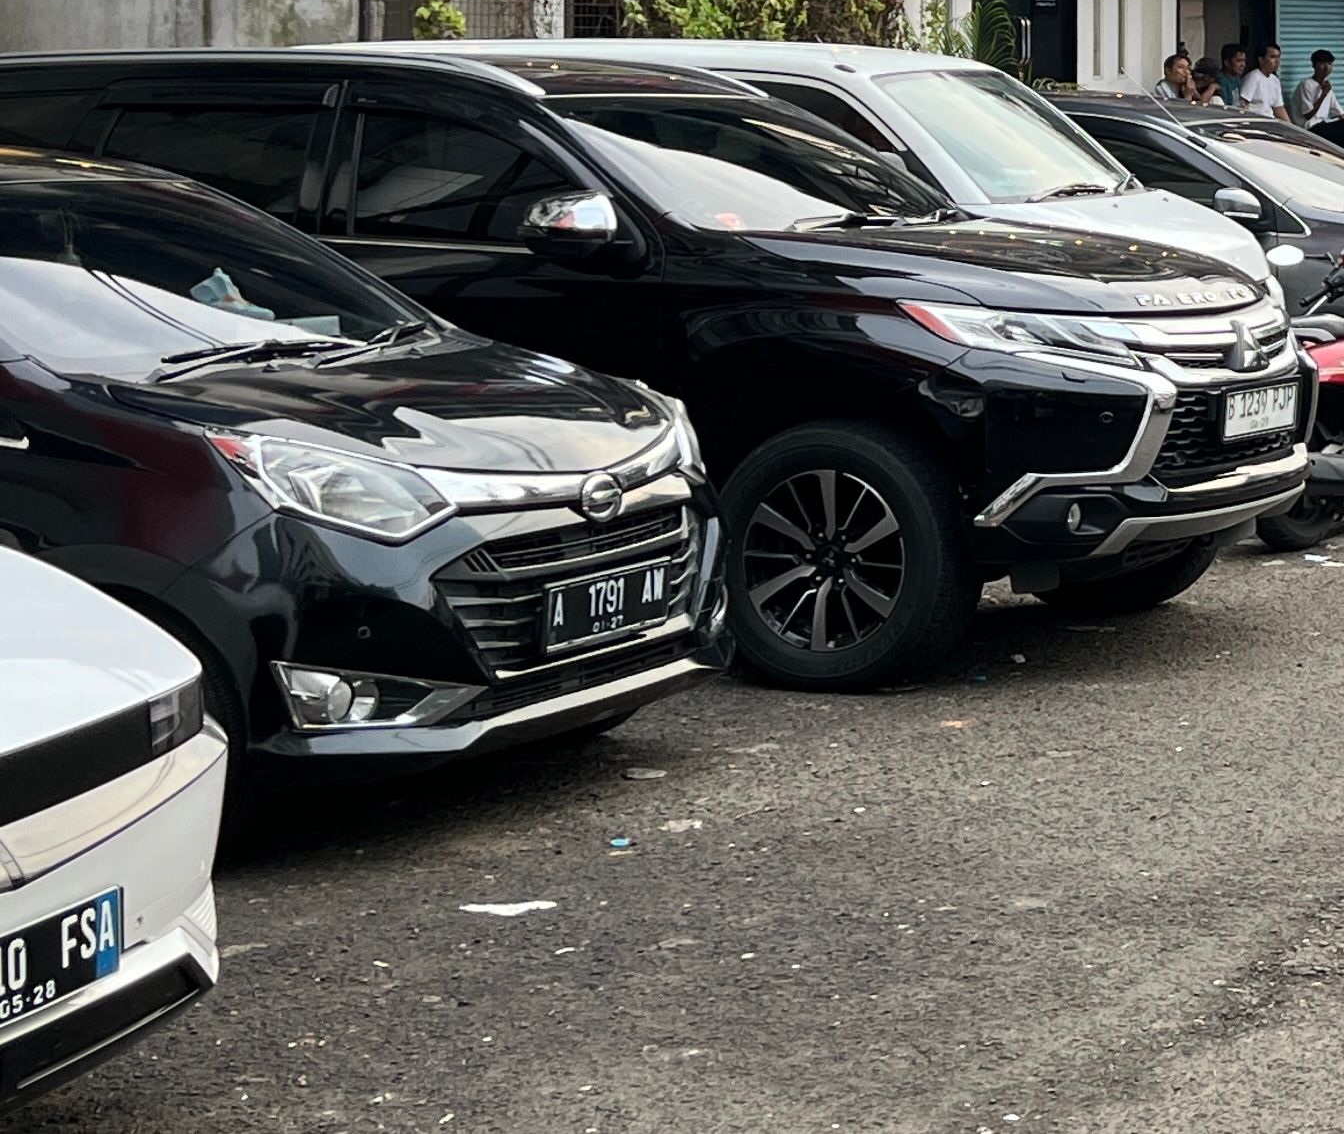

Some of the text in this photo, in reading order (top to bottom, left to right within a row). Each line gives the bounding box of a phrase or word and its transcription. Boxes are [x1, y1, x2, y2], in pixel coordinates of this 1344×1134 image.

[1226, 396, 1236, 421] B
[552, 592, 565, 627] A
[588, 577, 625, 618] 1791
[61, 899, 115, 969] FSA
